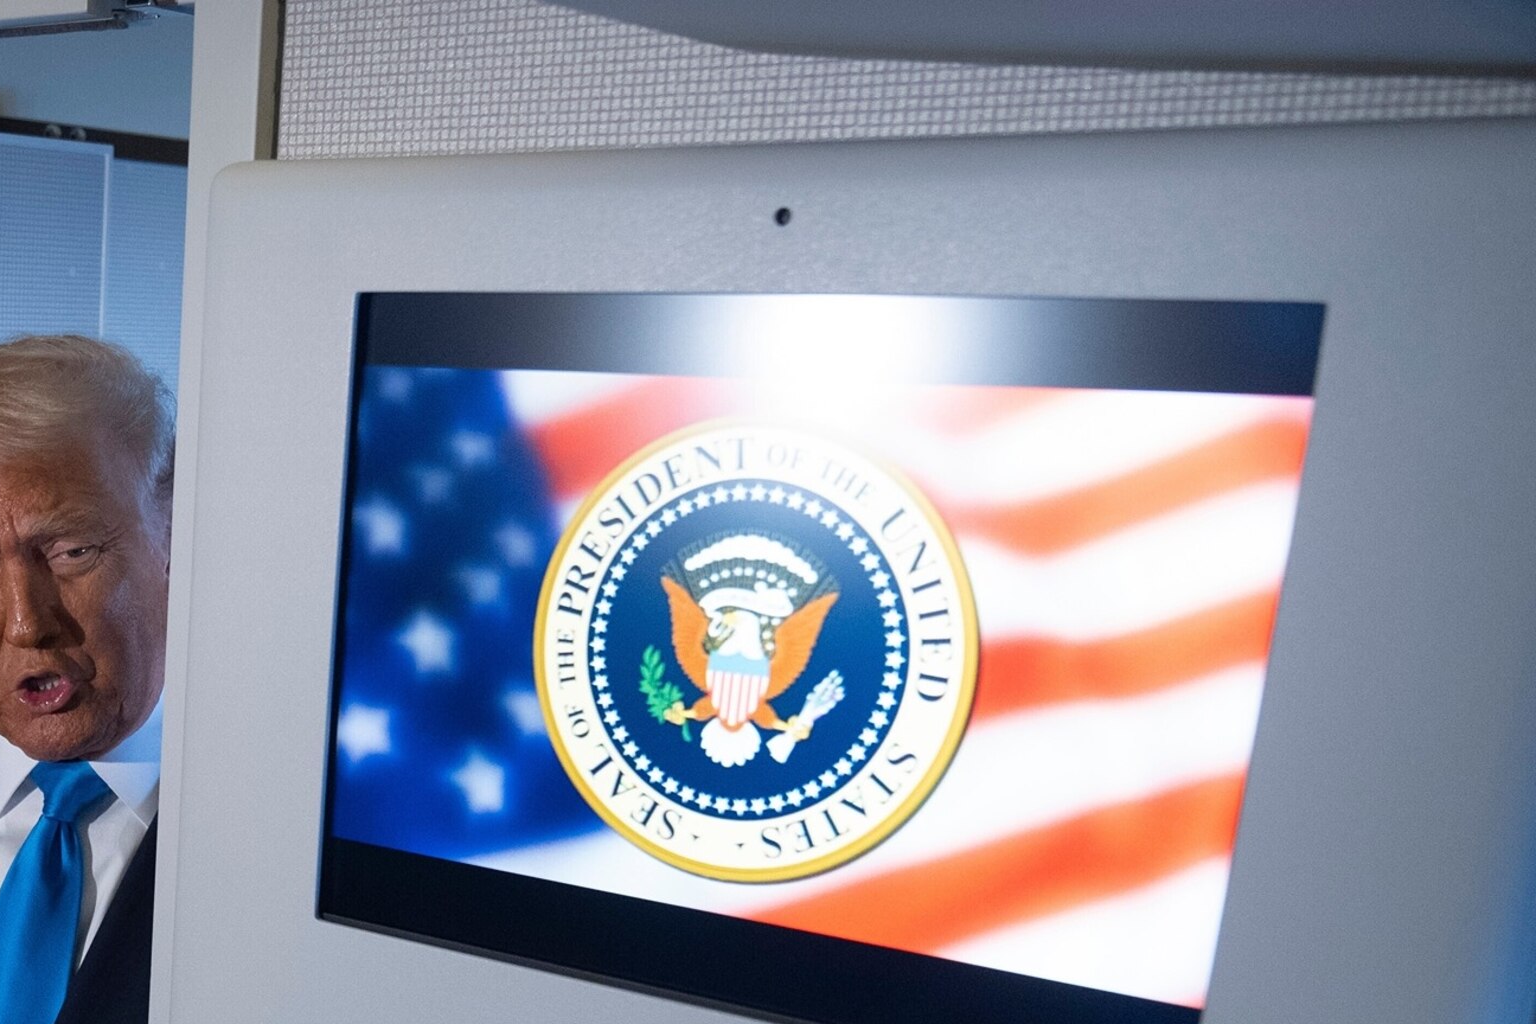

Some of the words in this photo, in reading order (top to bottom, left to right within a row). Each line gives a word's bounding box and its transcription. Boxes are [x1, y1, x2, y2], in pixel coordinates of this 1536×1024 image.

[766, 444, 805, 471] OF
[820, 458, 878, 508] THE
[557, 437, 754, 617] PRESIDENT
[880, 507, 953, 702] UNITED
[556, 629, 577, 689] THE
[565, 703, 591, 739] OF
[589, 743, 683, 840] SEAL
[761, 742, 918, 858] STATES
